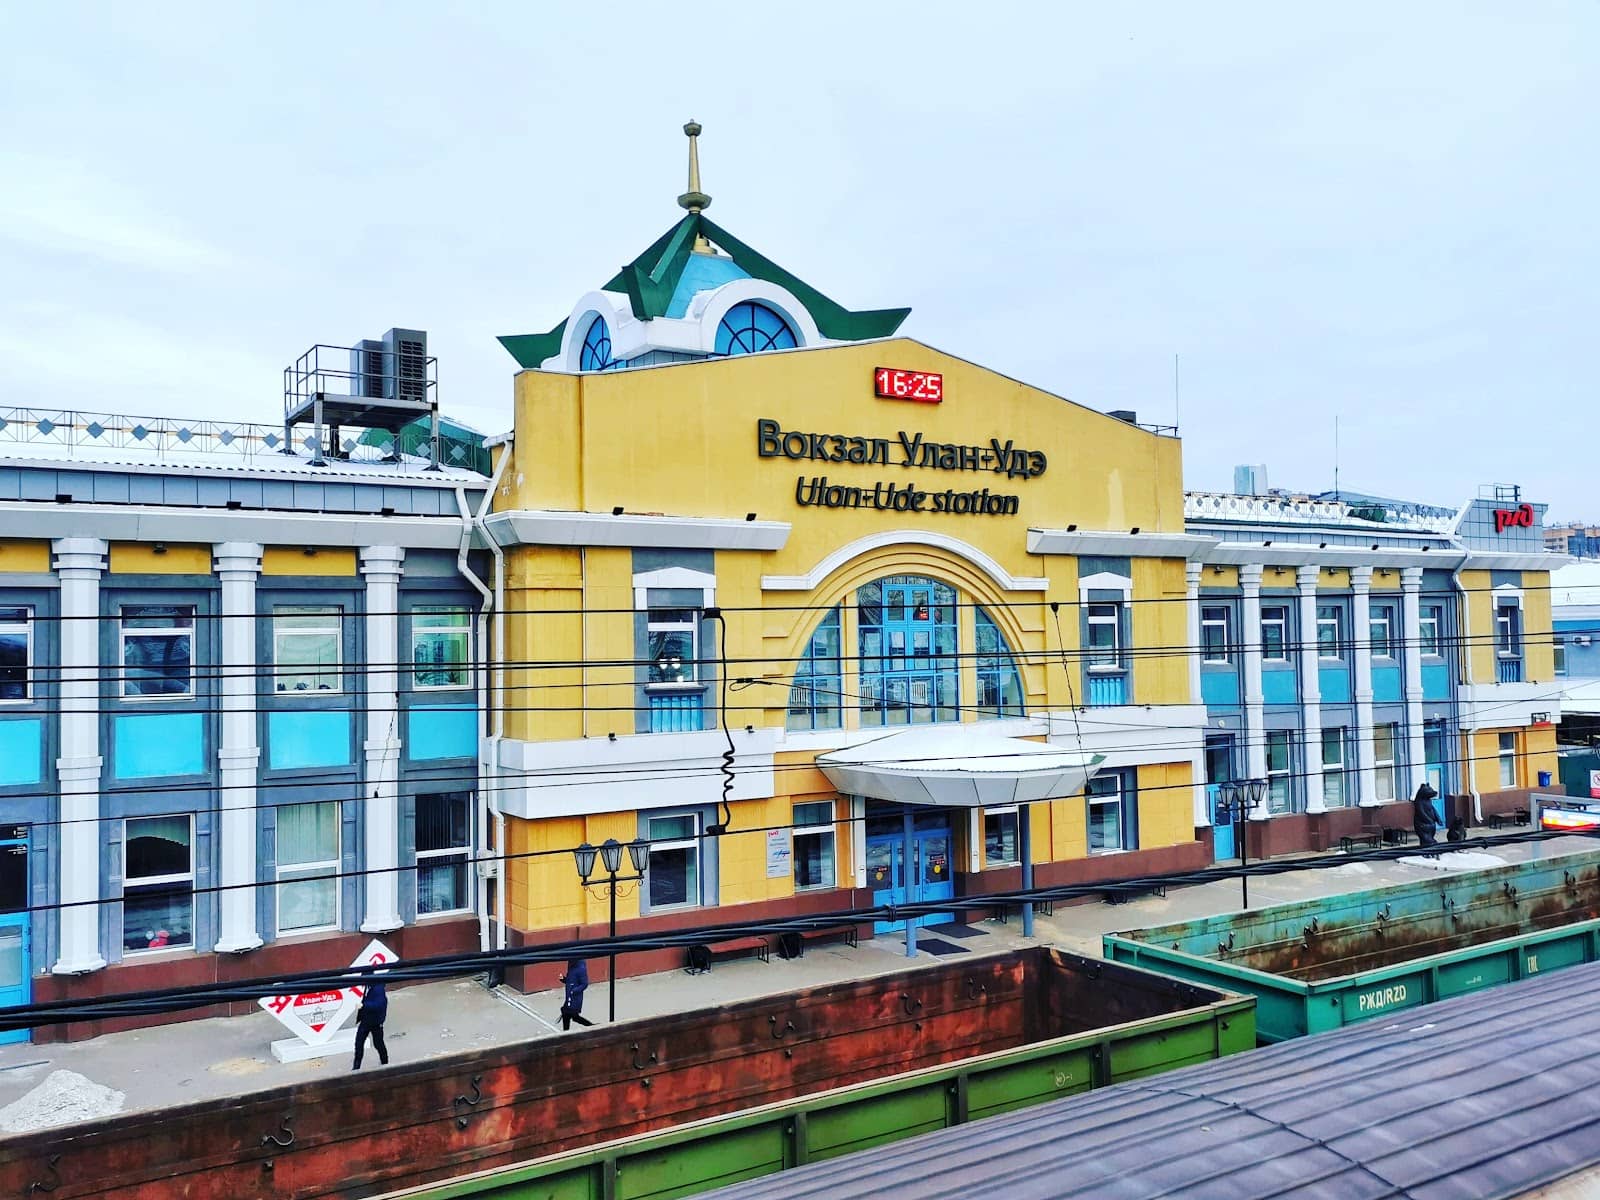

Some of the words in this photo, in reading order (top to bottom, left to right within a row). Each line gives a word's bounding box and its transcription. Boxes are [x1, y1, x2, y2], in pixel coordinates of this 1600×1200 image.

[878, 370, 941, 399] 16:25
[758, 418, 890, 465] Вокзал
[898, 431, 1048, 479] Улан-Удэ
[796, 476, 926, 512] Ulan-Ude
[932, 487, 1020, 515] station
[302, 993, 338, 1005] Улан-Удэ
[1359, 984, 1407, 1011] РЖД/RZD
